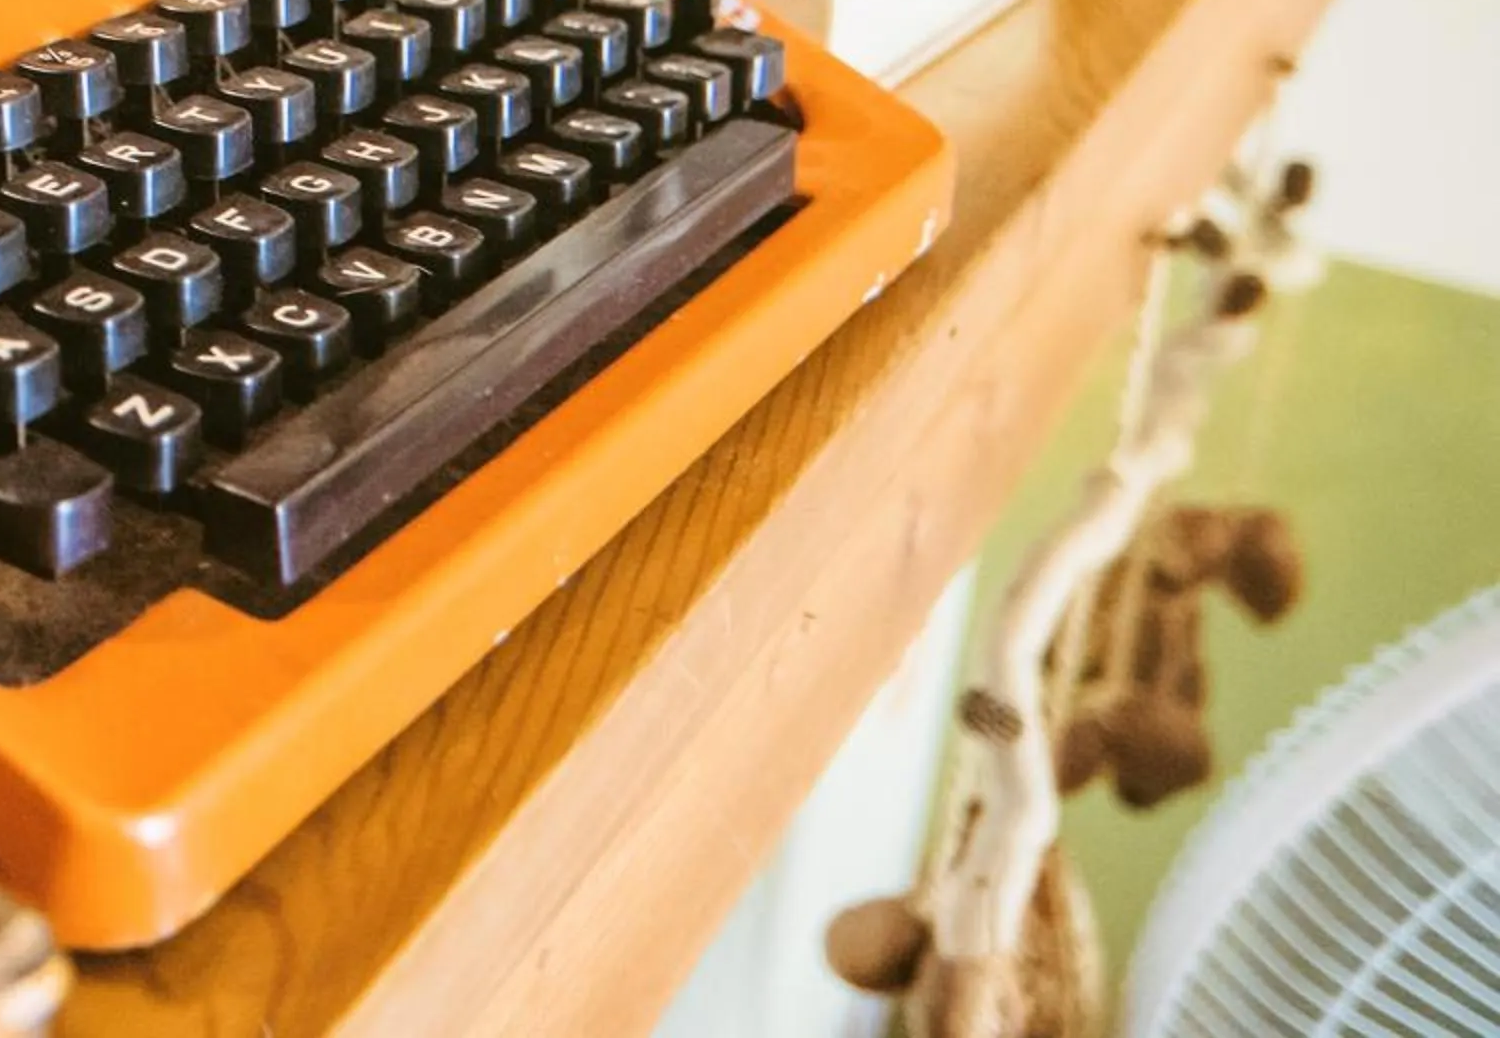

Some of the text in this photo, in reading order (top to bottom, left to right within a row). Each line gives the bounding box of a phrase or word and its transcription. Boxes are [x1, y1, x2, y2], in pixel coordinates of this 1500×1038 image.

[27, 174, 81, 197] E
[106, 144, 155, 163] R
[176, 105, 219, 123] T
[243, 76, 284, 91] Y
[305, 47, 348, 65] U
[65, 286, 114, 312] S
[139, 248, 189, 270] D
[214, 207, 252, 231] F
[290, 175, 333, 193] G
[346, 141, 395, 161] H
[418, 104, 452, 122] J
[462, 72, 507, 90] K
[113, 153, 567, 427] Z X C V B N M
